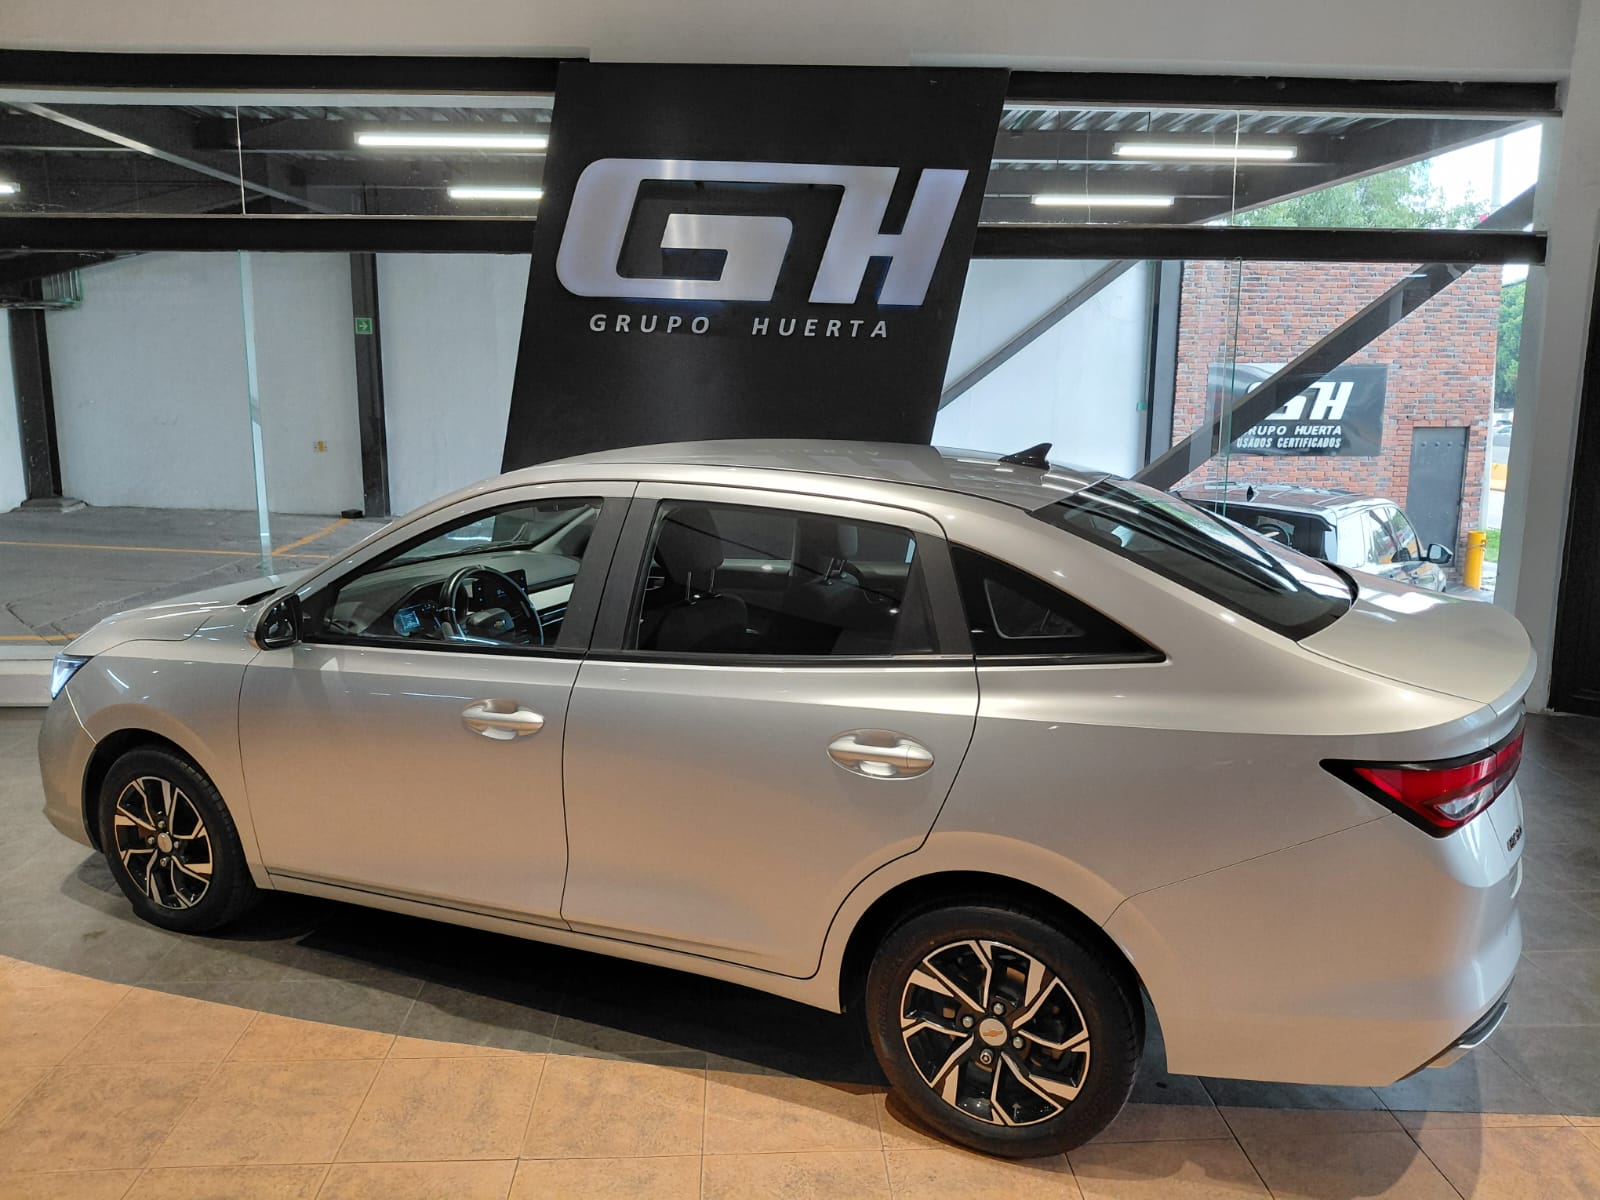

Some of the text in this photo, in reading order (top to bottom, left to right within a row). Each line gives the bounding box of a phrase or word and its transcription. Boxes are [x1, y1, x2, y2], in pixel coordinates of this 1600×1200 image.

[556, 158, 968, 306] GH
[589, 314, 888, 338] GRUPO HUERTA
[1246, 425, 1342, 436] RUPO HUERTA
[1236, 437, 1342, 449] USADOS CERTIFICADOS
